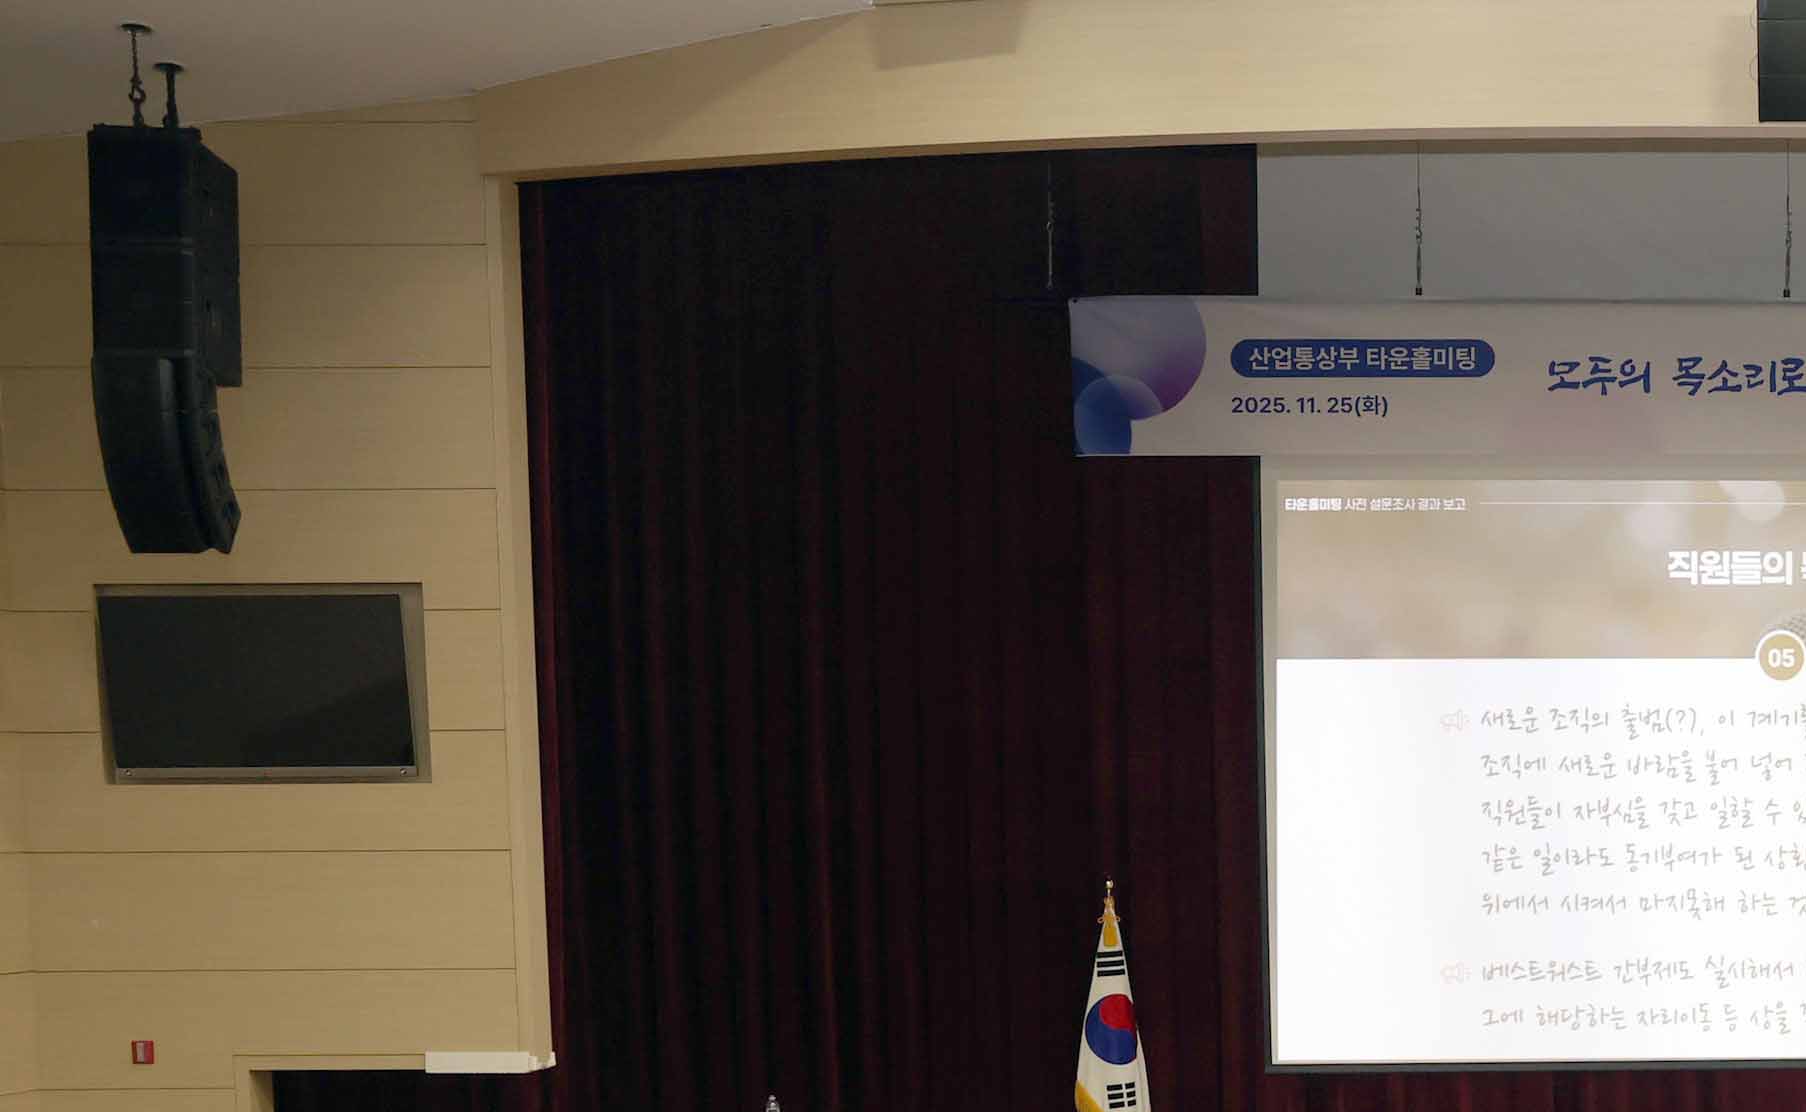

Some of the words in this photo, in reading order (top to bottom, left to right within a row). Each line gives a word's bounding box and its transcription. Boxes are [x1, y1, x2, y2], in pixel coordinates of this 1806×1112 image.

[1249, 346, 1360, 371] 산업통상부
[1366, 346, 1476, 371] 타운홀미팅
[1547, 356, 1651, 396] 모두의
[1231, 396, 1291, 414] 2025.
[1296, 397, 1321, 414] 11.
[1327, 394, 1388, 418] 25(화)
[1344, 497, 1367, 511] 사전
[1369, 497, 1417, 511] 설문조사
[1417, 497, 1441, 511] 결과
[1443, 497, 1466, 511] 보고
[1667, 550, 1793, 586] 직원들의
[1767, 648, 1796, 668] 05
[1480, 705, 1540, 734] 새로운
[1548, 706, 1609, 734] 조직의
[1621, 703, 1704, 741] 출범(?),
[1717, 709, 1735, 726] 이
[1480, 753, 1547, 780] 조직에
[1558, 751, 1617, 780] 새로운
[1627, 749, 1697, 784] 바람을
[1705, 750, 1738, 787] 불어
[1481, 795, 1561, 831] 직원들이
[1572, 795, 1650, 830] 자부심을
[1658, 798, 1698, 827] 갖고
[1709, 795, 1755, 830] 일할
[1764, 798, 1782, 825] 수
[1481, 843, 1524, 873] 같은
[1533, 841, 1615, 877] 일이라도
[1625, 842, 1723, 873] 동기부여가
[1734, 845, 1756, 871] 된
[1481, 893, 1549, 916] 위에서
[1560, 893, 1627, 915] 시켜서
[1639, 887, 1725, 921] 마지못해
[1737, 889, 1779, 917] 하는
[1482, 960, 1603, 983] 베스트워스트
[1612, 956, 1695, 987] 간부제도
[1704, 955, 1794, 990] 실시해서
[1482, 1008, 1523, 1026] 그에
[1535, 1003, 1627, 1031] 해당하는
[1636, 1002, 1713, 1032] 자리이동
[1723, 1003, 1738, 1033] 등
[1749, 1001, 1792, 1036] 상을
